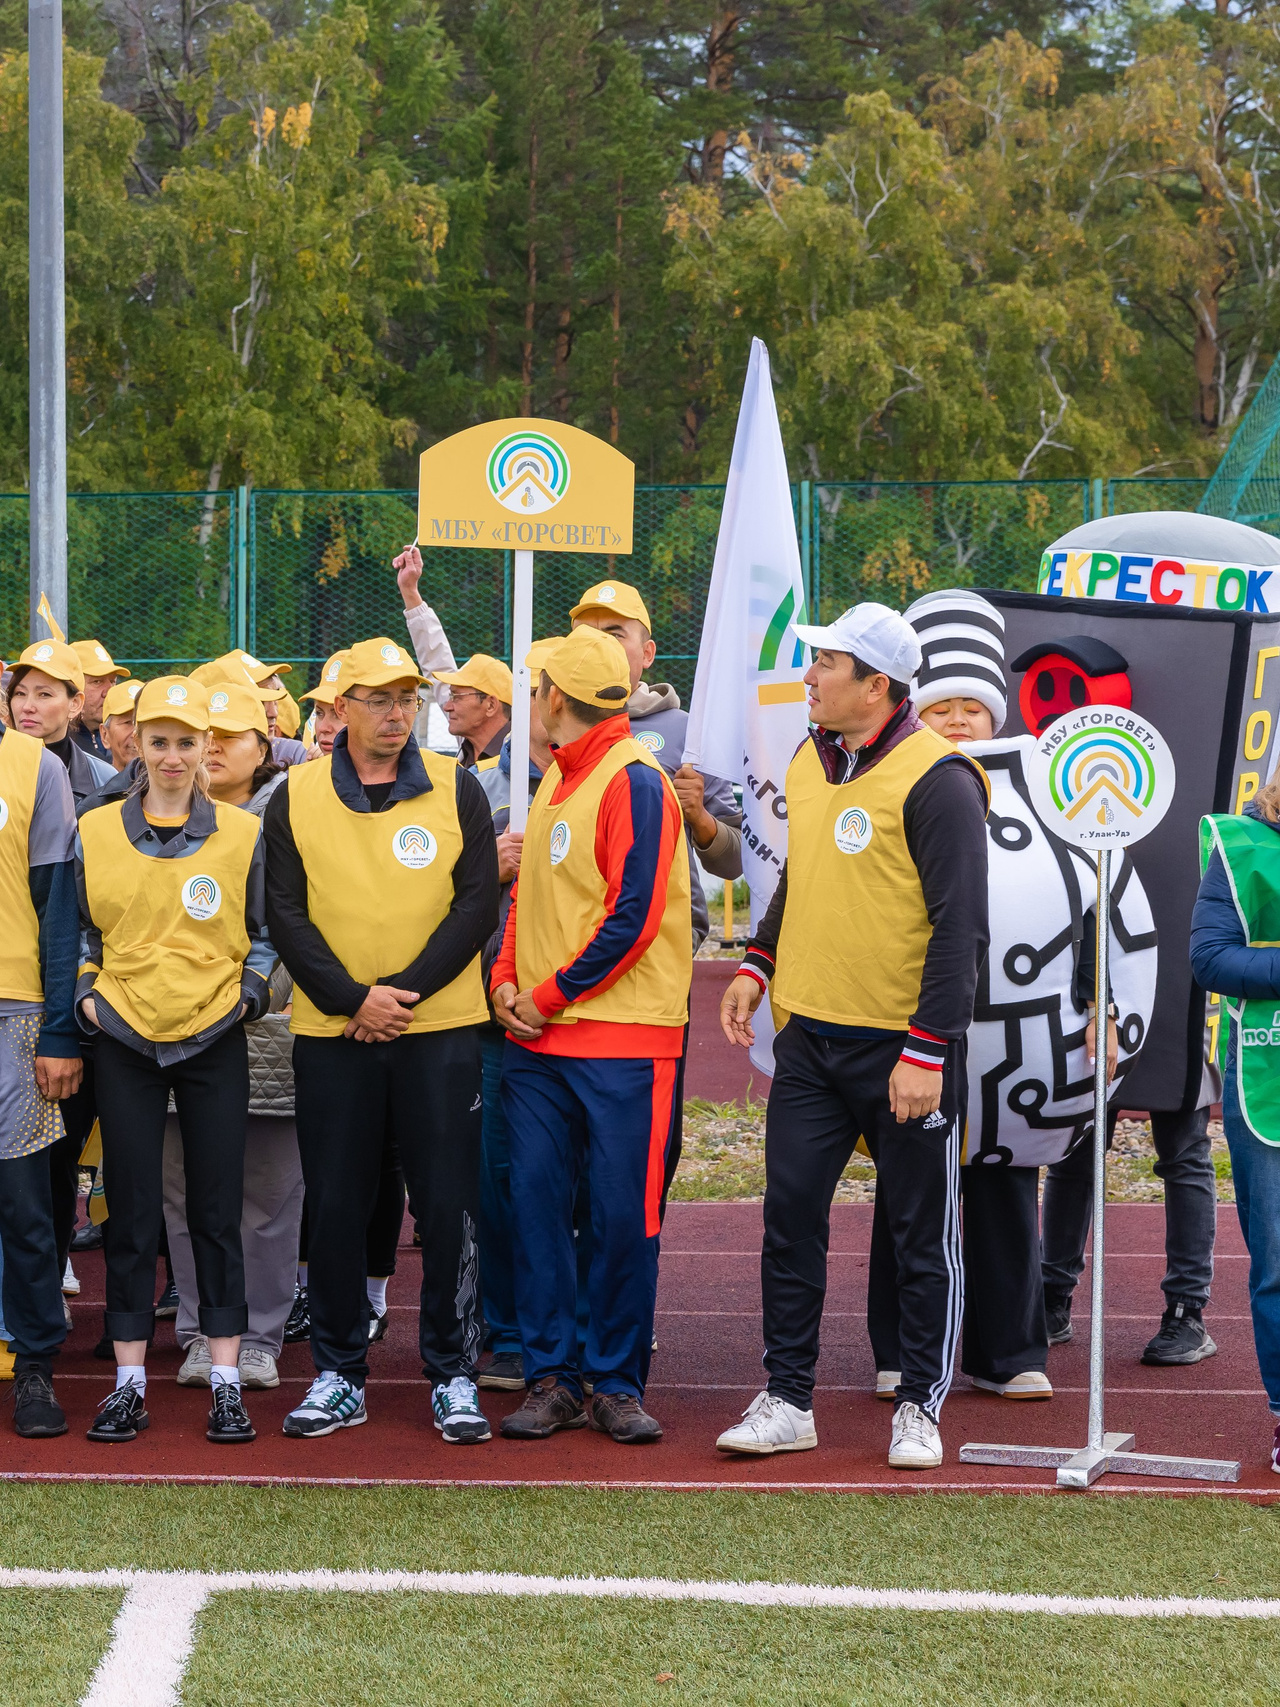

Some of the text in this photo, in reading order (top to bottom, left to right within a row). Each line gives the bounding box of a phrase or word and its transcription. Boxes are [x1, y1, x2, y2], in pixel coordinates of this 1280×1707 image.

[430, 518, 622, 546] МБУ «ГОРСВЕТ»
[1040, 713, 1156, 756] МБУ «ГОРСВЕТ»
[1089, 829, 1130, 838] Улан-Удэ
